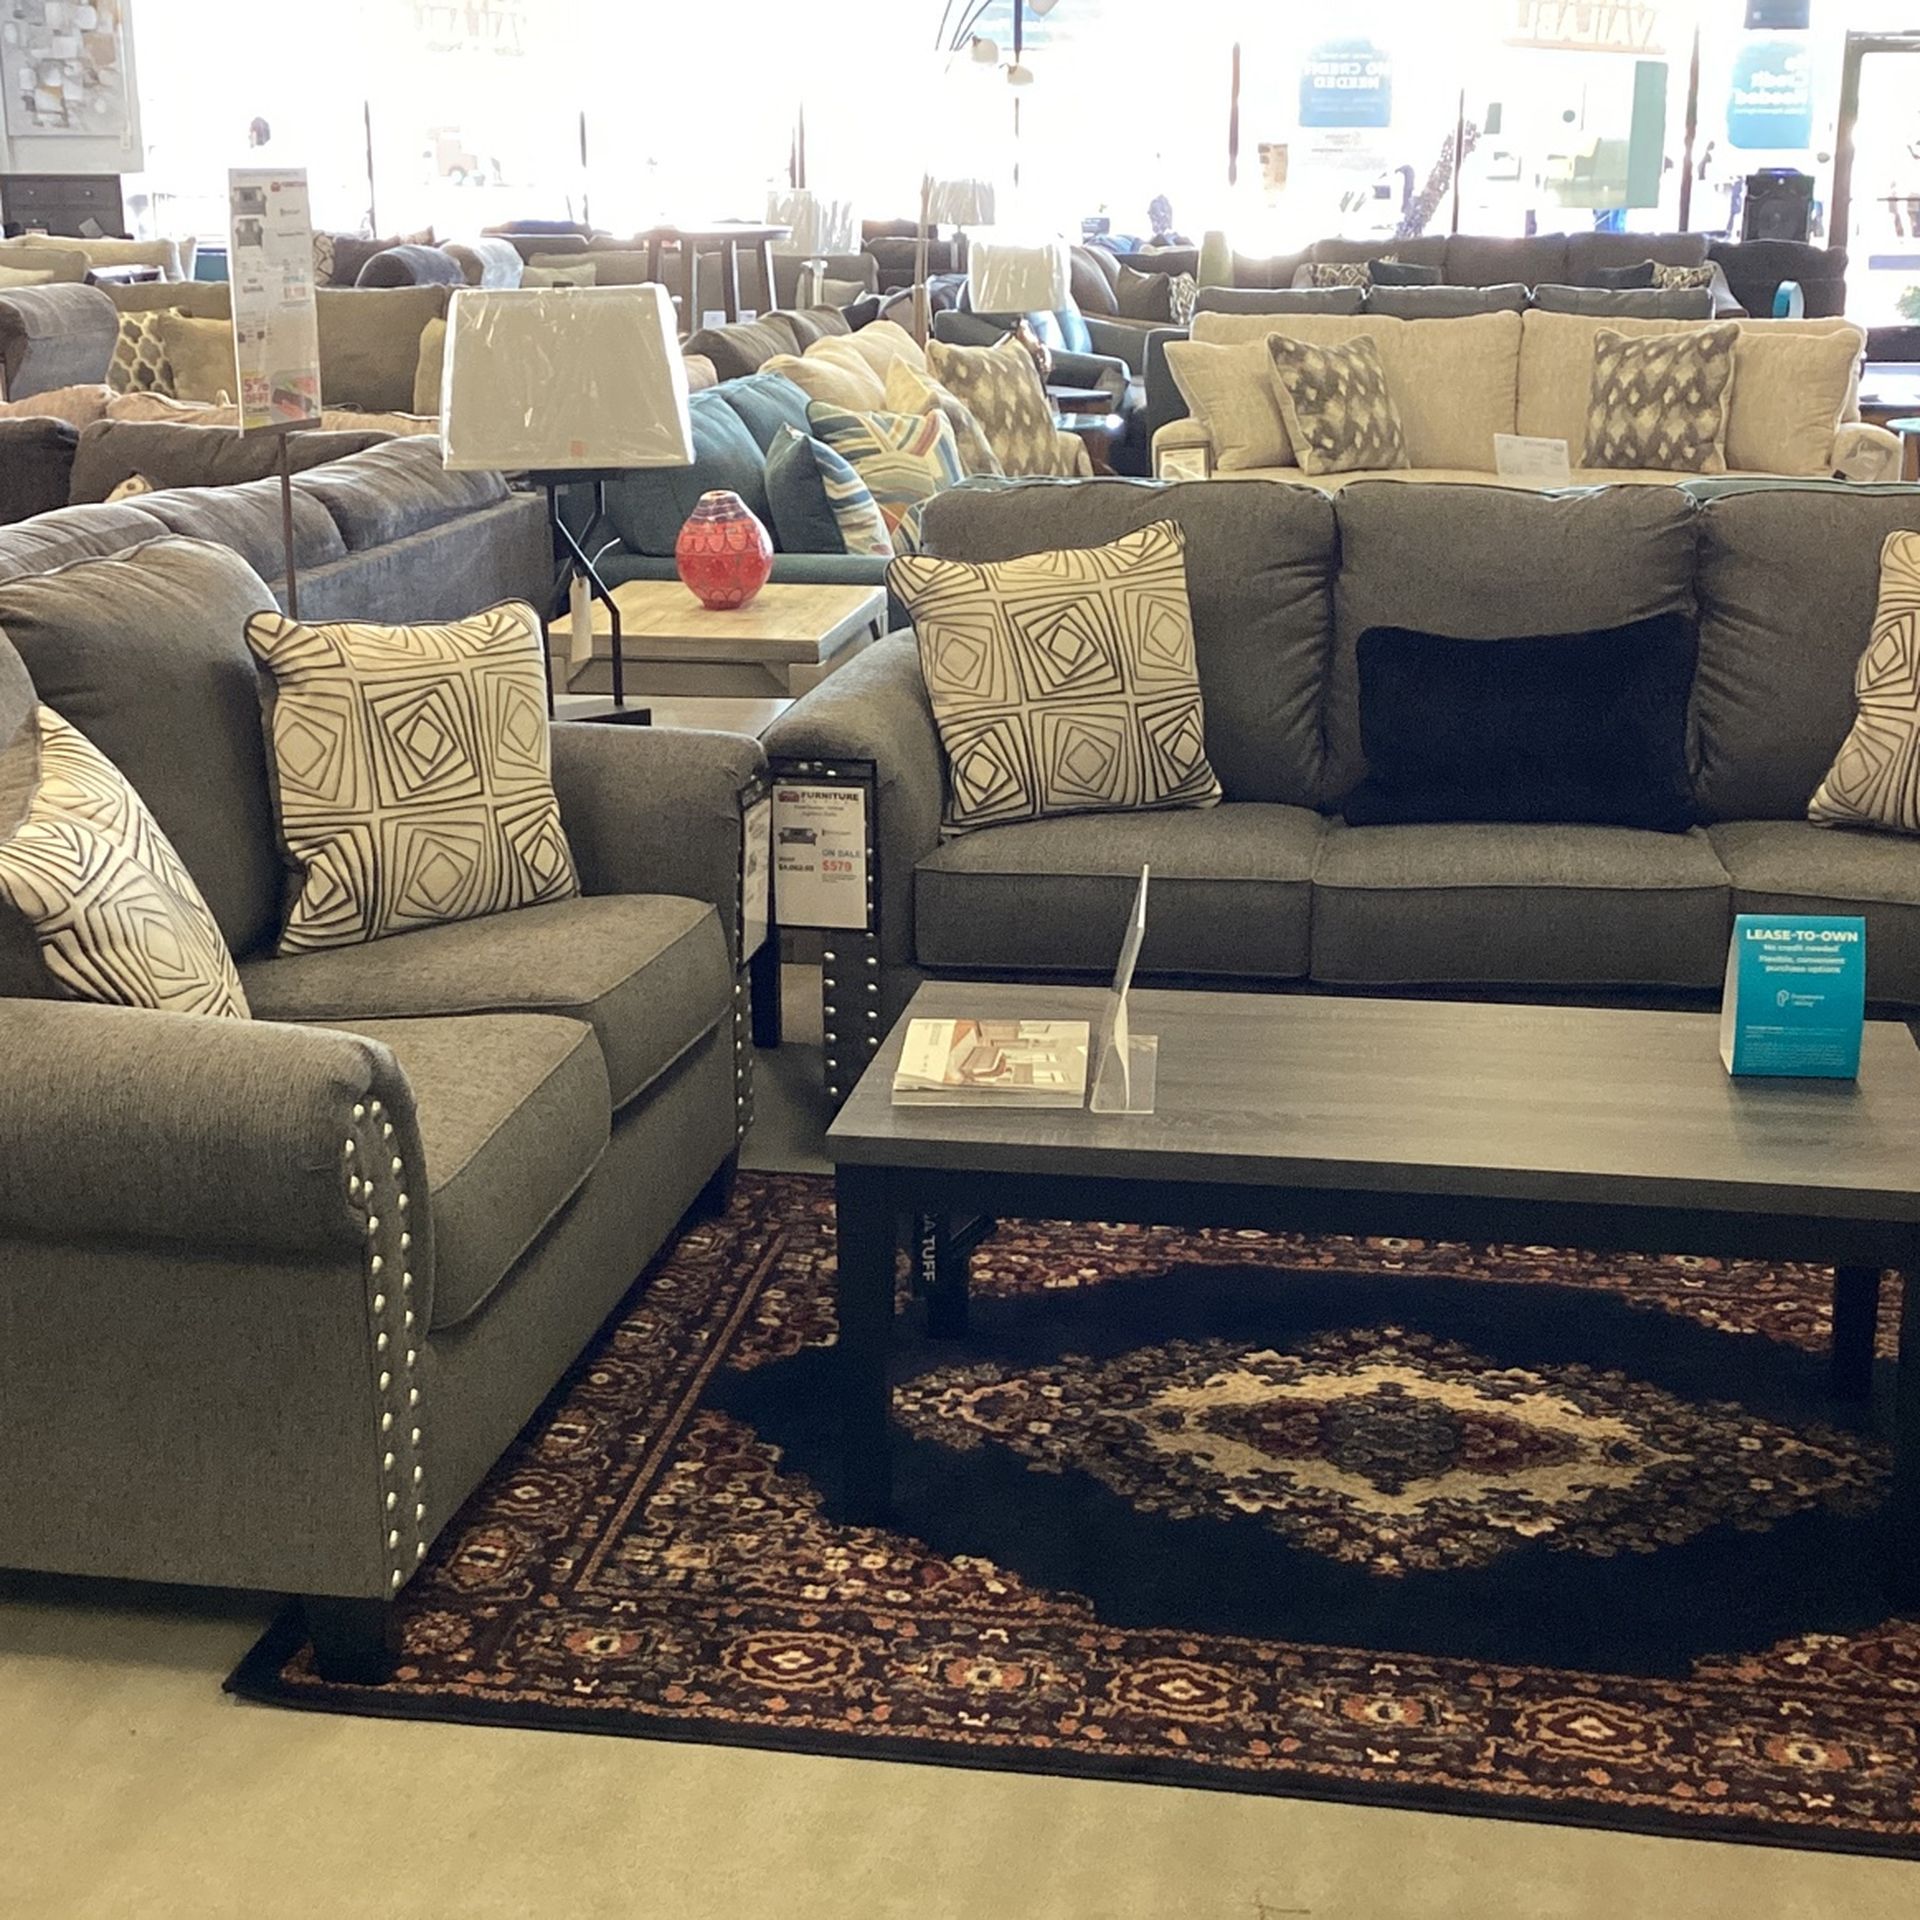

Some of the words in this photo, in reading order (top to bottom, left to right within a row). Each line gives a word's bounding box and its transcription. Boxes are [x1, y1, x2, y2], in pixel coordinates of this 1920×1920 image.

[800, 791, 859, 801] FURNITURE
[822, 849, 835, 857] ON
[1746, 929, 1858, 942] LEASE-TO-OWN
